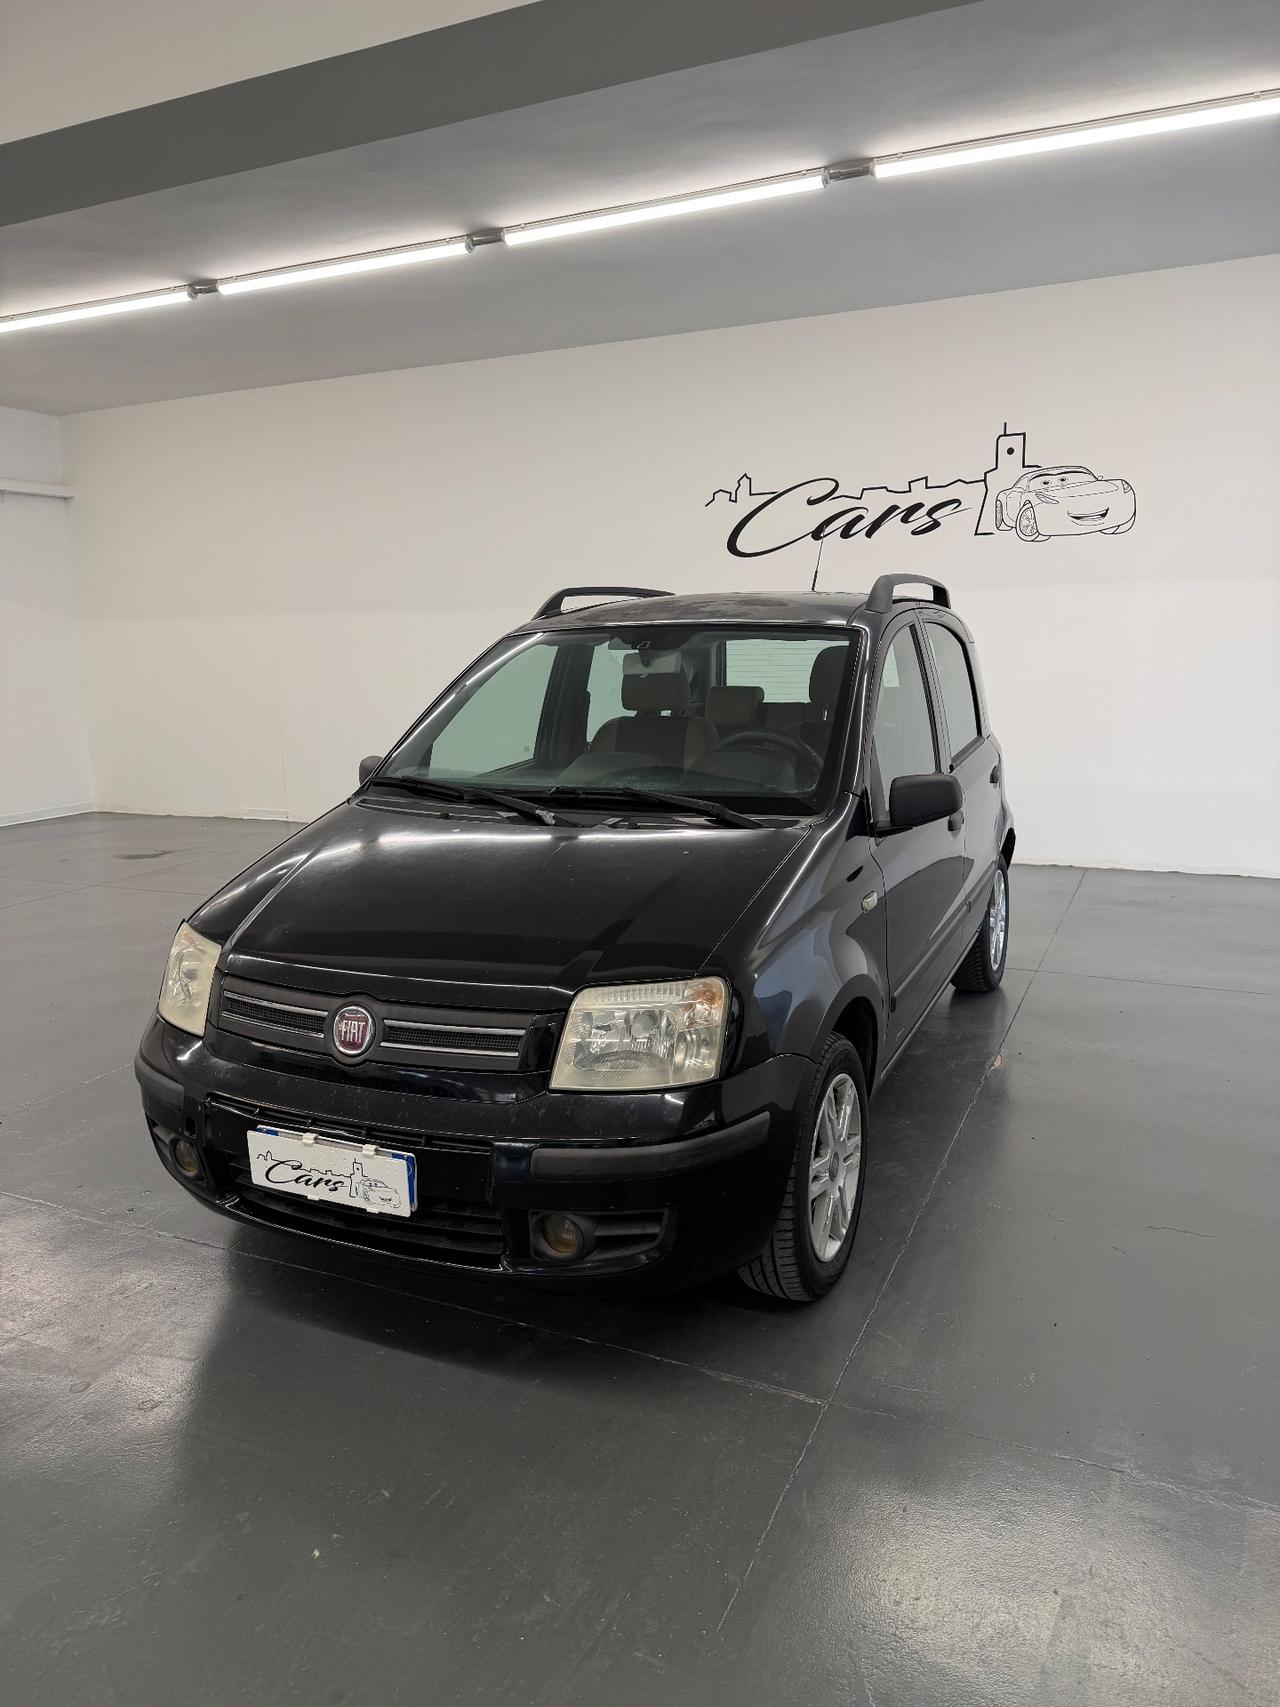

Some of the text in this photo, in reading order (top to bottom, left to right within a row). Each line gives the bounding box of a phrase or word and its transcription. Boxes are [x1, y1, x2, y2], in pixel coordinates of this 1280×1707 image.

[726, 477, 968, 558] Cars
[340, 1019, 366, 1043] FIAT
[265, 1159, 346, 1192] Cars
